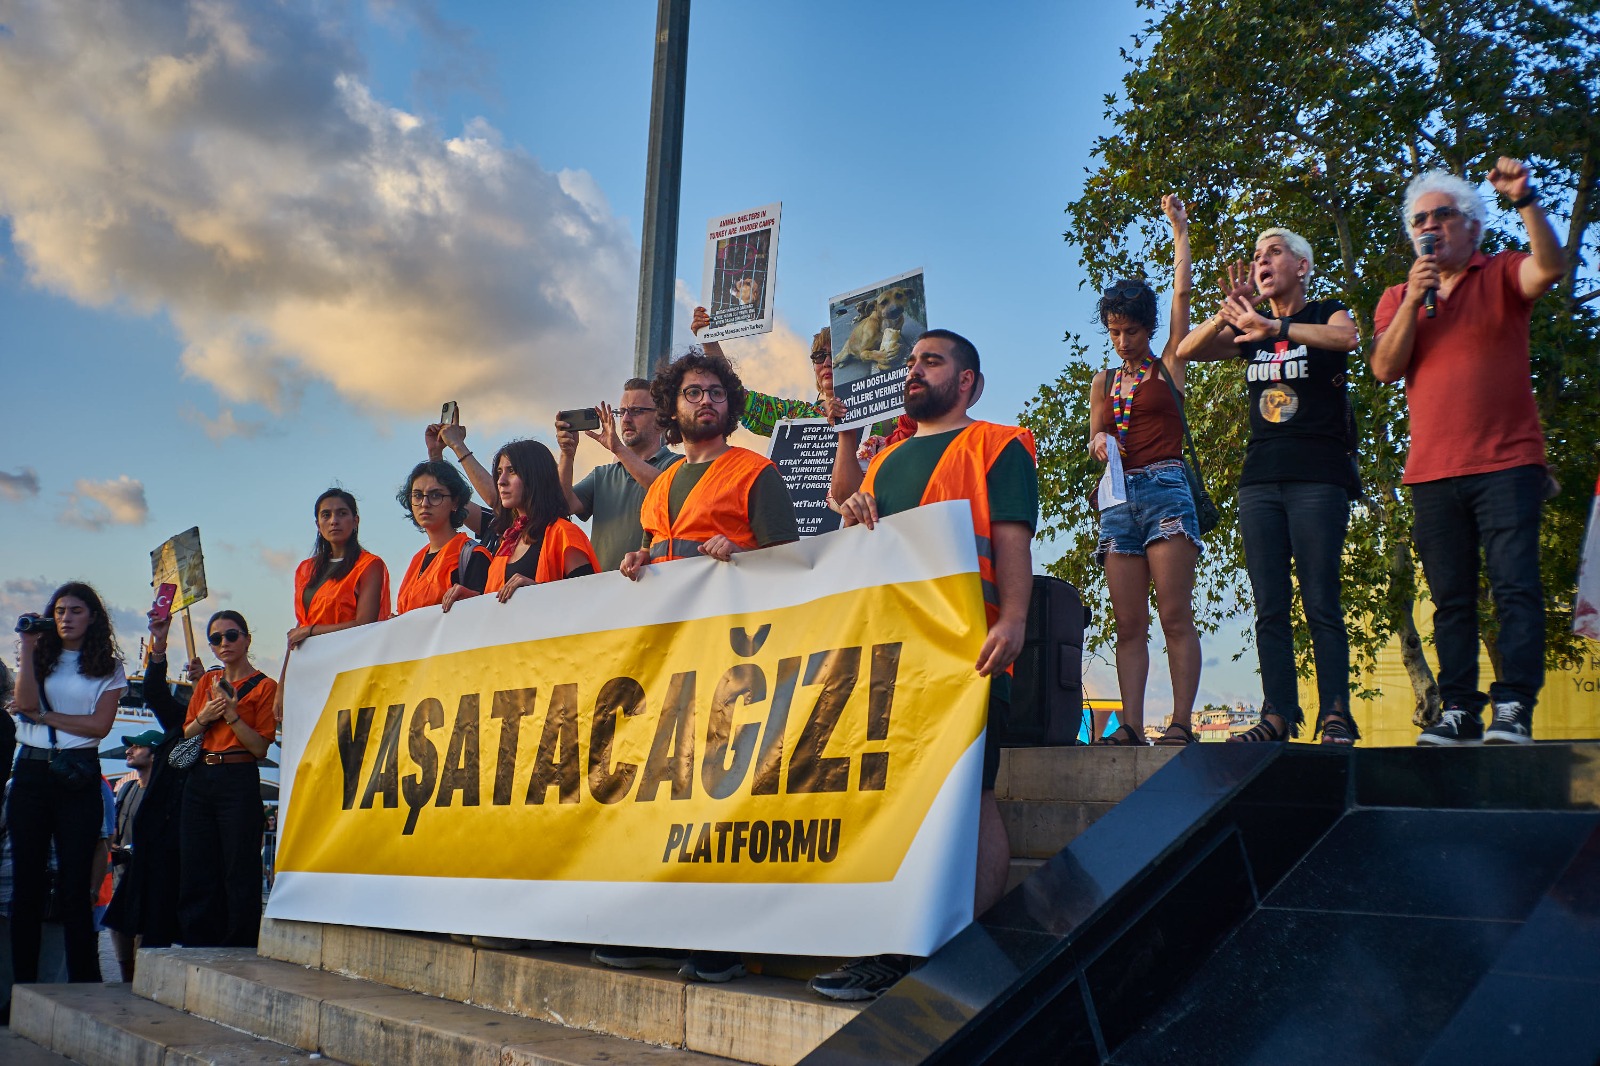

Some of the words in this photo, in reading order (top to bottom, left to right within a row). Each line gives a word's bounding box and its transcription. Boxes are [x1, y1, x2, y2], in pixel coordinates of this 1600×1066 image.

[719, 217, 737, 228] ANIMAL
[737, 211, 761, 224] SHELTERS
[760, 209, 767, 218] IN
[709, 229, 728, 240] TURKEY
[727, 227, 738, 236] ARE
[738, 222, 759, 233] MURDER
[758, 218, 776, 228] CAMPS
[851, 380, 866, 393] CAN
[841, 390, 874, 408] ATİLLERE
[862, 406, 868, 416] O
[869, 399, 890, 414] KANLI
[890, 395, 905, 408] ELL
[811, 441, 839, 449] ALLOWS
[818, 433, 835, 441] LAW
[337, 623, 903, 835] YAŞATACAĞIZ!
[662, 818, 842, 864] PLATFORMU
